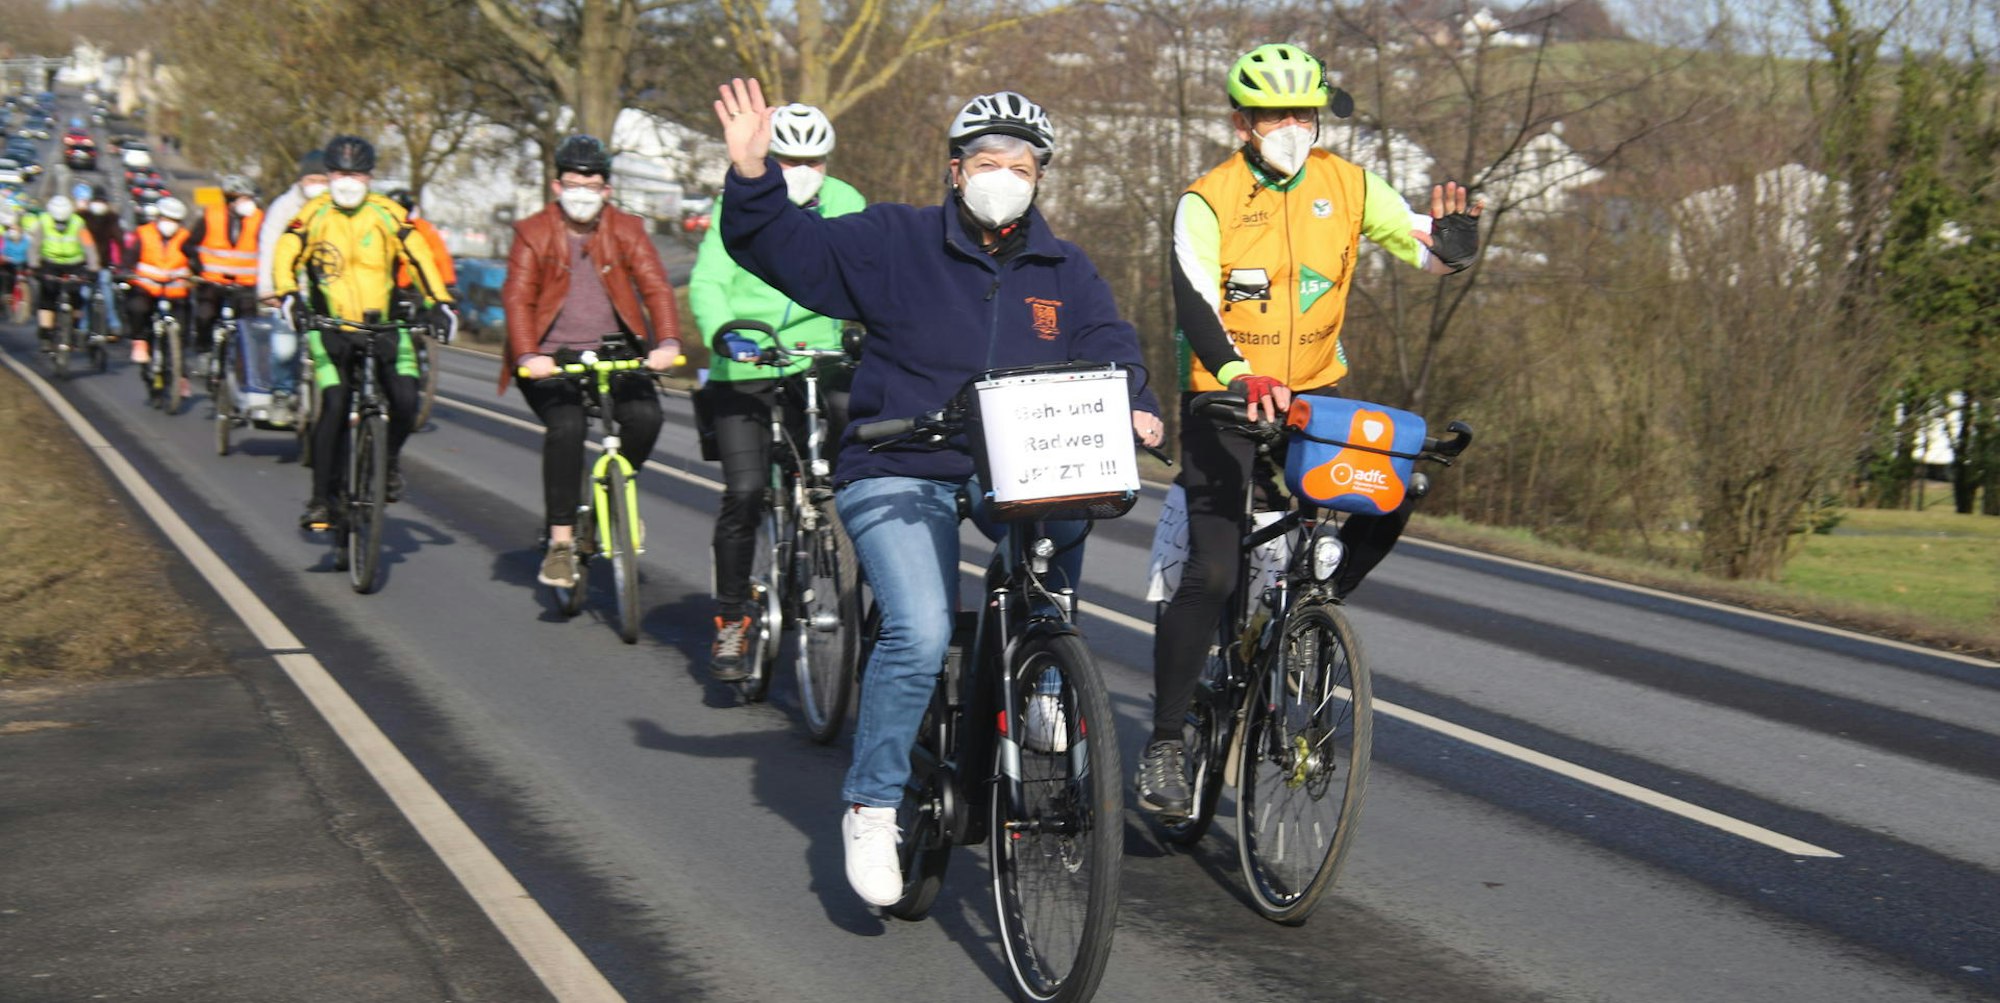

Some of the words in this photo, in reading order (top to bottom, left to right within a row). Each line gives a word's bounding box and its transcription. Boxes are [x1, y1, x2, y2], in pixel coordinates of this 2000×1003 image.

[1069, 398, 1104, 415] und
[1025, 433, 1104, 451] Radweg
[1018, 463, 1085, 484] JEZT
[1354, 469, 1387, 484] adfc
